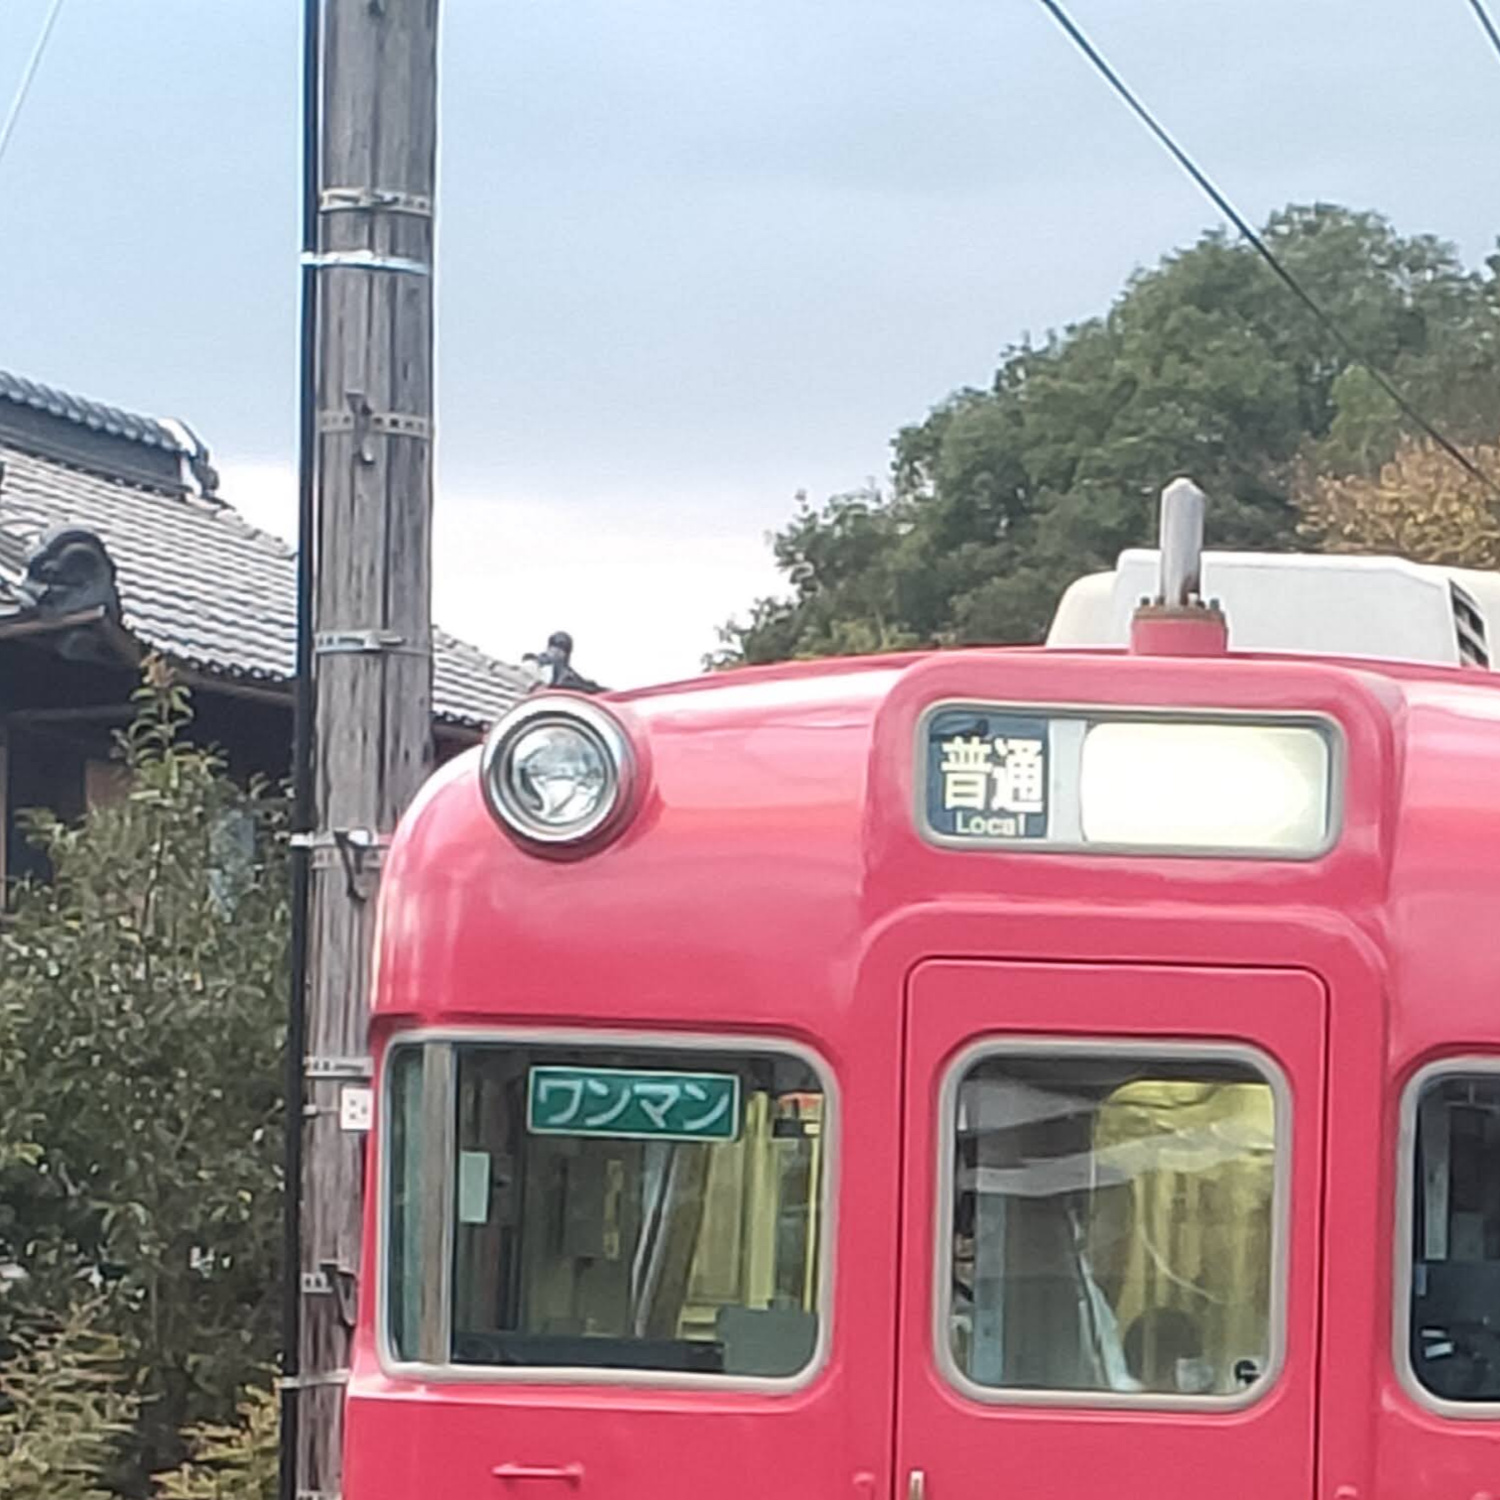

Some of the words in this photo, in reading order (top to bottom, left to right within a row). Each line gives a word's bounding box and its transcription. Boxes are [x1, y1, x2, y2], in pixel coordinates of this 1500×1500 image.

[940, 736, 1043, 812] 普通
[955, 812, 1026, 835] Local
[538, 1078, 730, 1130] ワンマン
